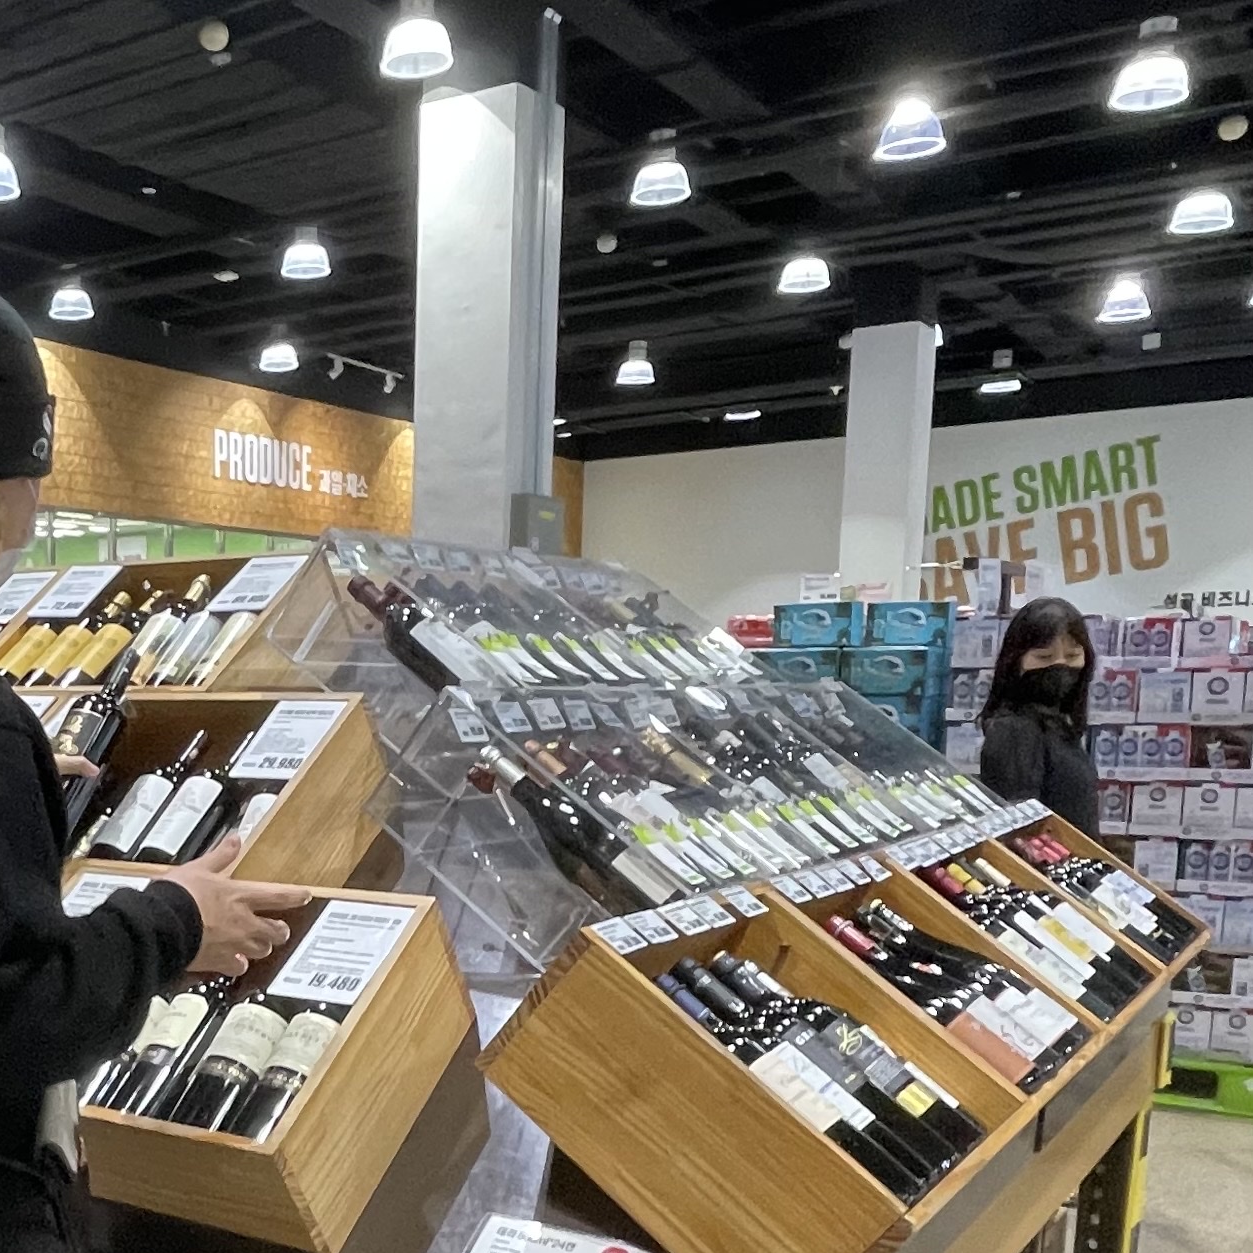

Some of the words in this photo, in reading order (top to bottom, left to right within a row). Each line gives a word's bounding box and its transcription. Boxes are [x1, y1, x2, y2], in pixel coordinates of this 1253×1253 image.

[214, 429, 313, 492] PRODUCE
[925, 473, 1005, 535] ADE
[1012, 435, 1161, 514] SMART
[920, 517, 1038, 605] AVE
[1056, 492, 1170, 585] BIG
[1202, 589, 1253, 607] 비즈니
[308, 972, 363, 992] 19,480
